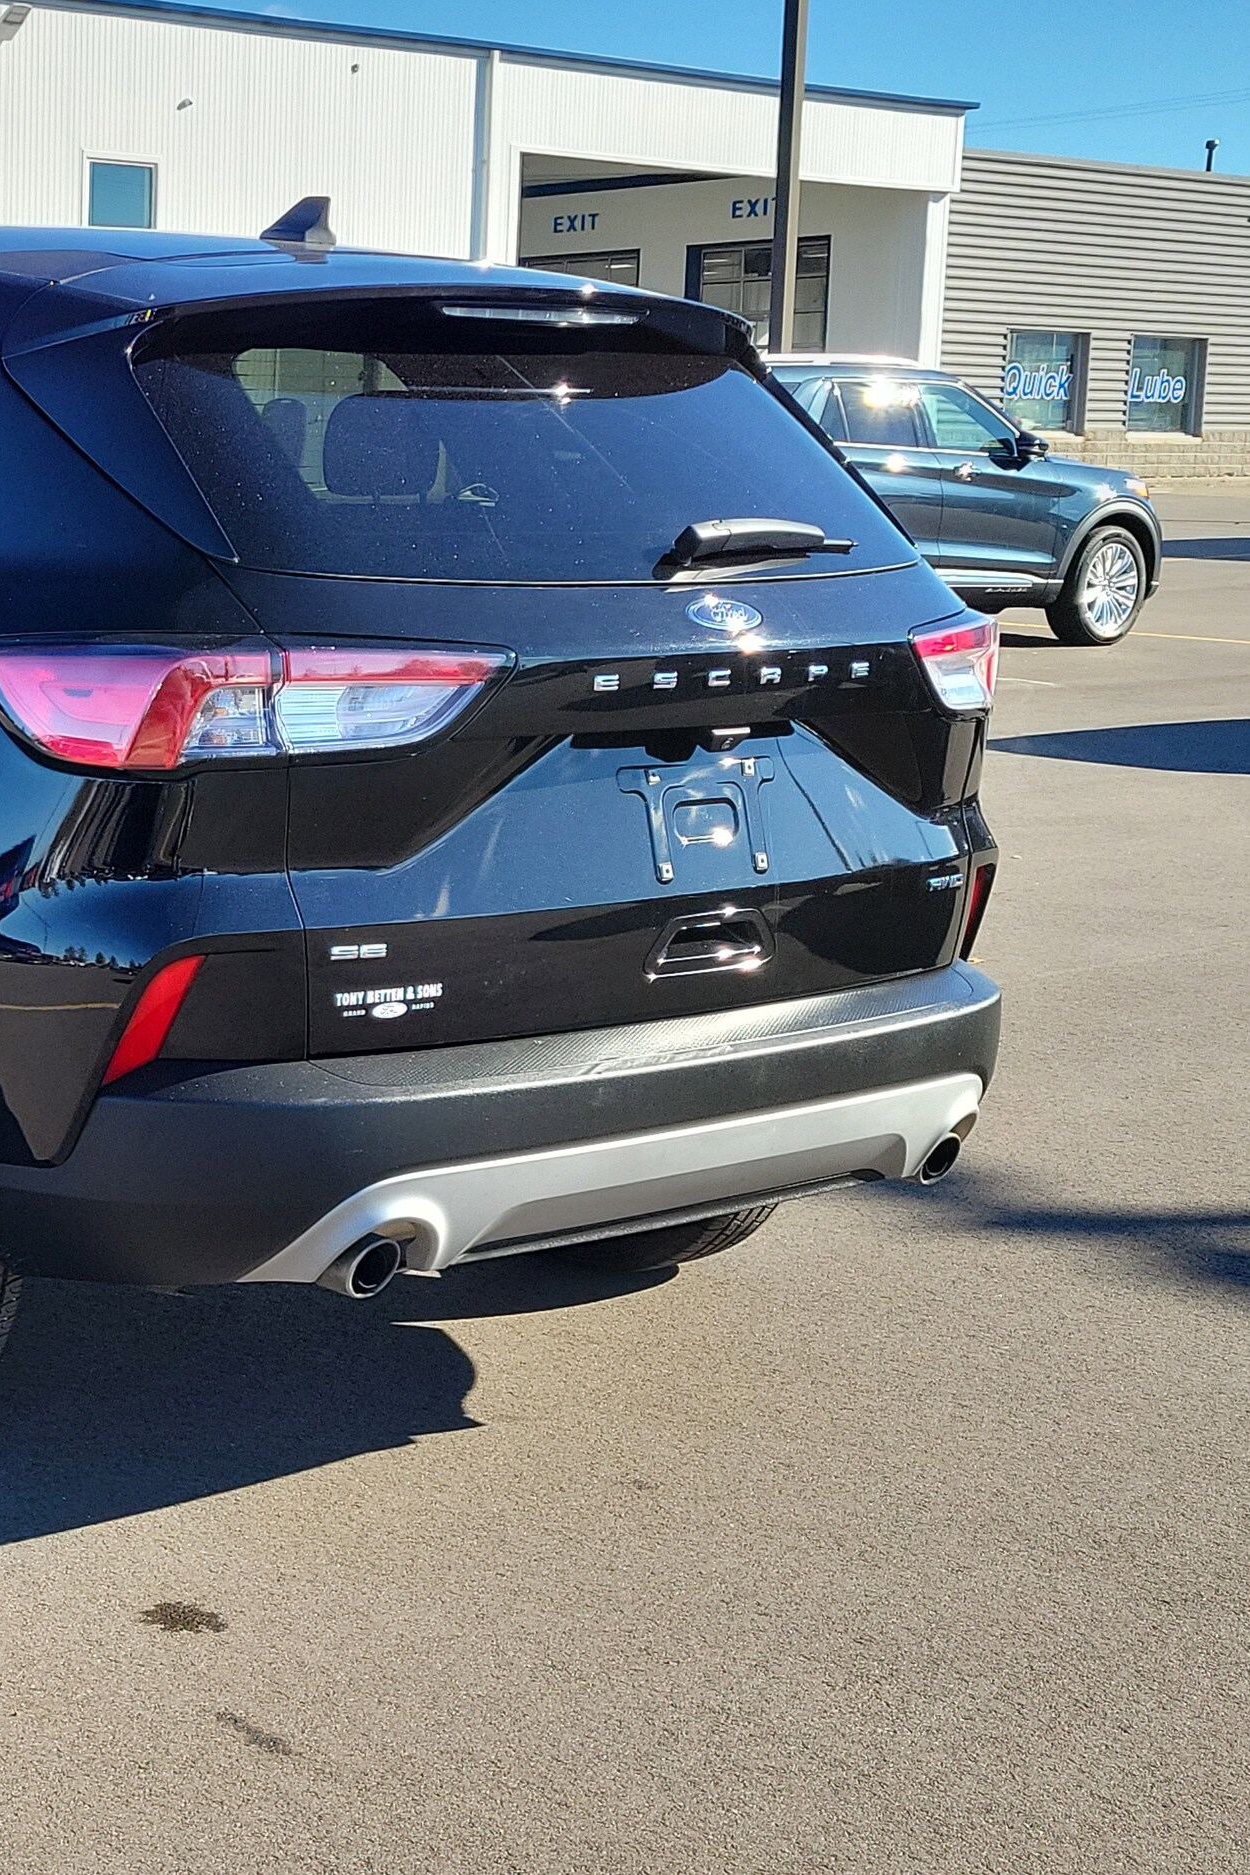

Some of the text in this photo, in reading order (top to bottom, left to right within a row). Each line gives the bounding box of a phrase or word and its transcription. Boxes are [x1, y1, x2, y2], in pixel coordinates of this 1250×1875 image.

[731, 197, 776, 218] EXI
[553, 213, 599, 233] EXIT
[1004, 362, 1186, 402] Quick Lube
[593, 661, 870, 691] ESCAPE
[330, 943, 388, 960] SE
[335, 983, 443, 1007] TONY BETTEN & SONS
